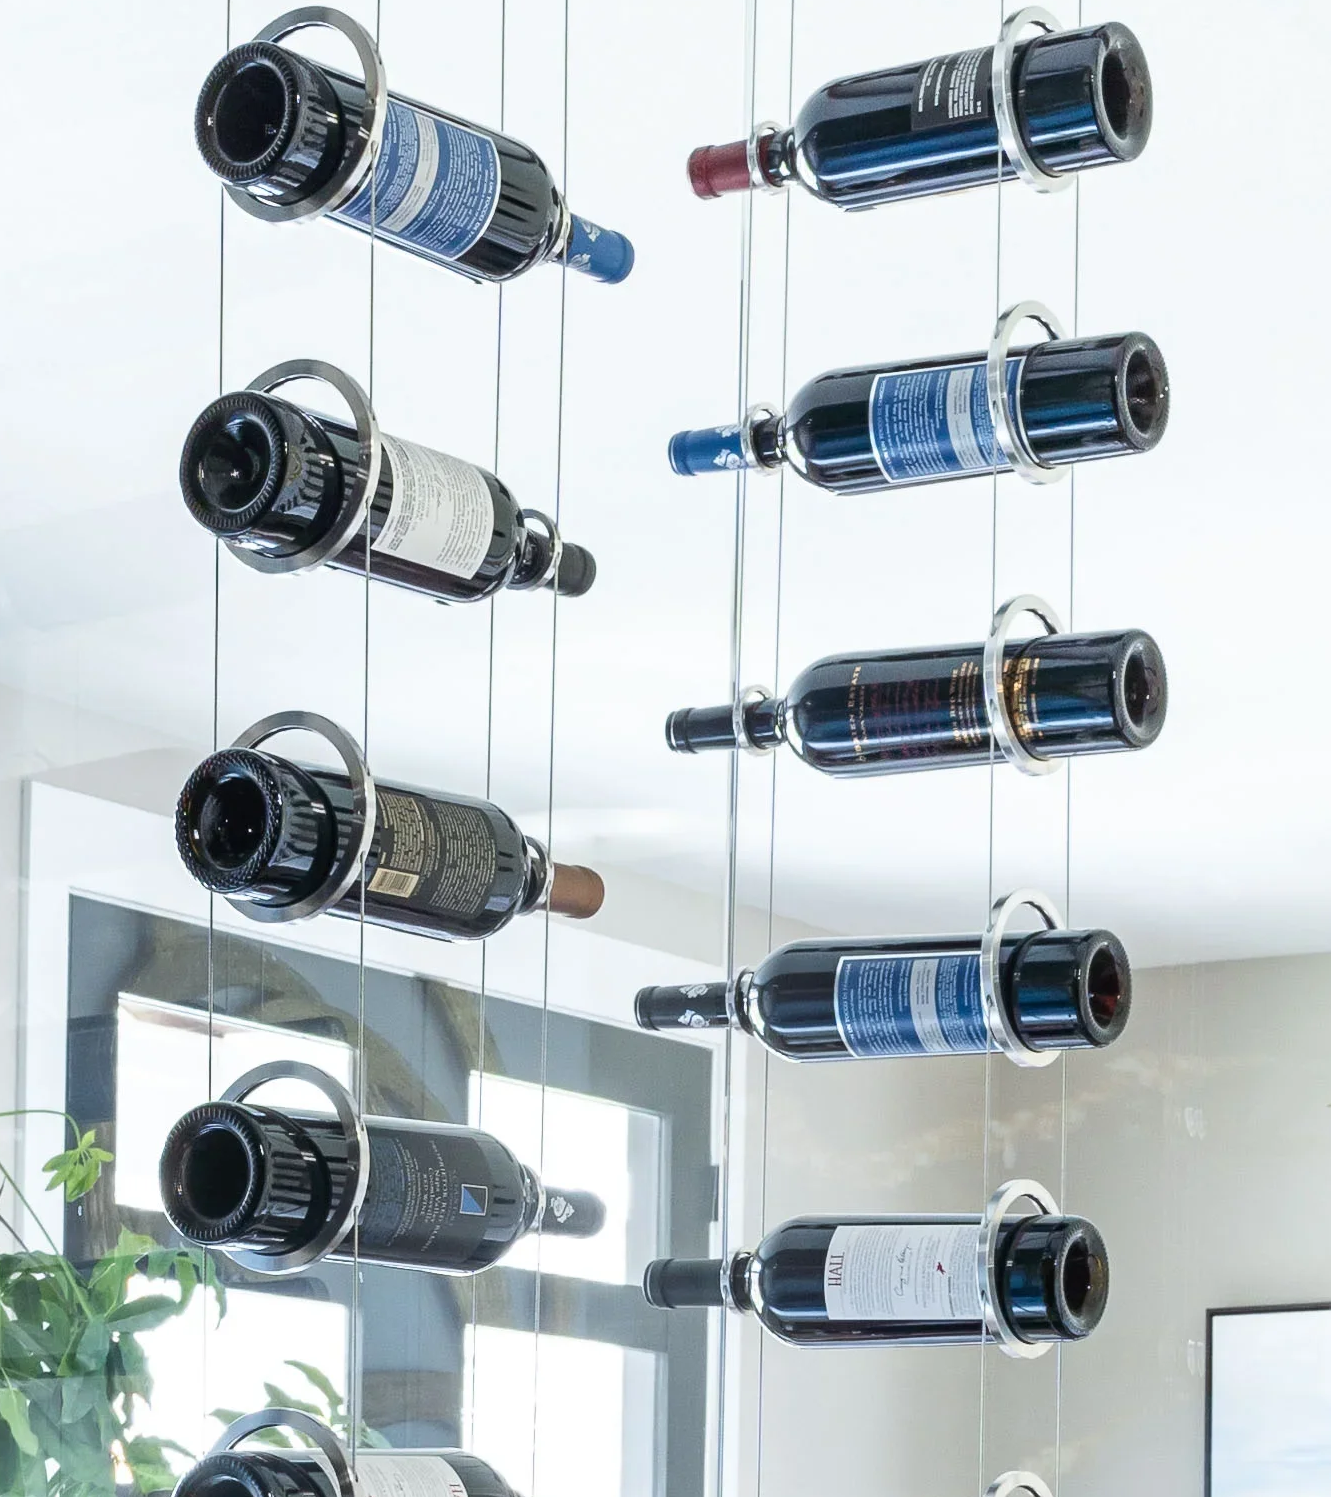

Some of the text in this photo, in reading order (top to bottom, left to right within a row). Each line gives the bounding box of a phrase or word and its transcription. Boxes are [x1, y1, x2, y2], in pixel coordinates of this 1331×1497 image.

[479, 197, 491, 219] TOCCO
[842, 1000, 850, 1022] TOCCO
[420, 1194, 428, 1216] WINE
[431, 1196, 441, 1222] Valley
[828, 1252, 845, 1287] HALL
